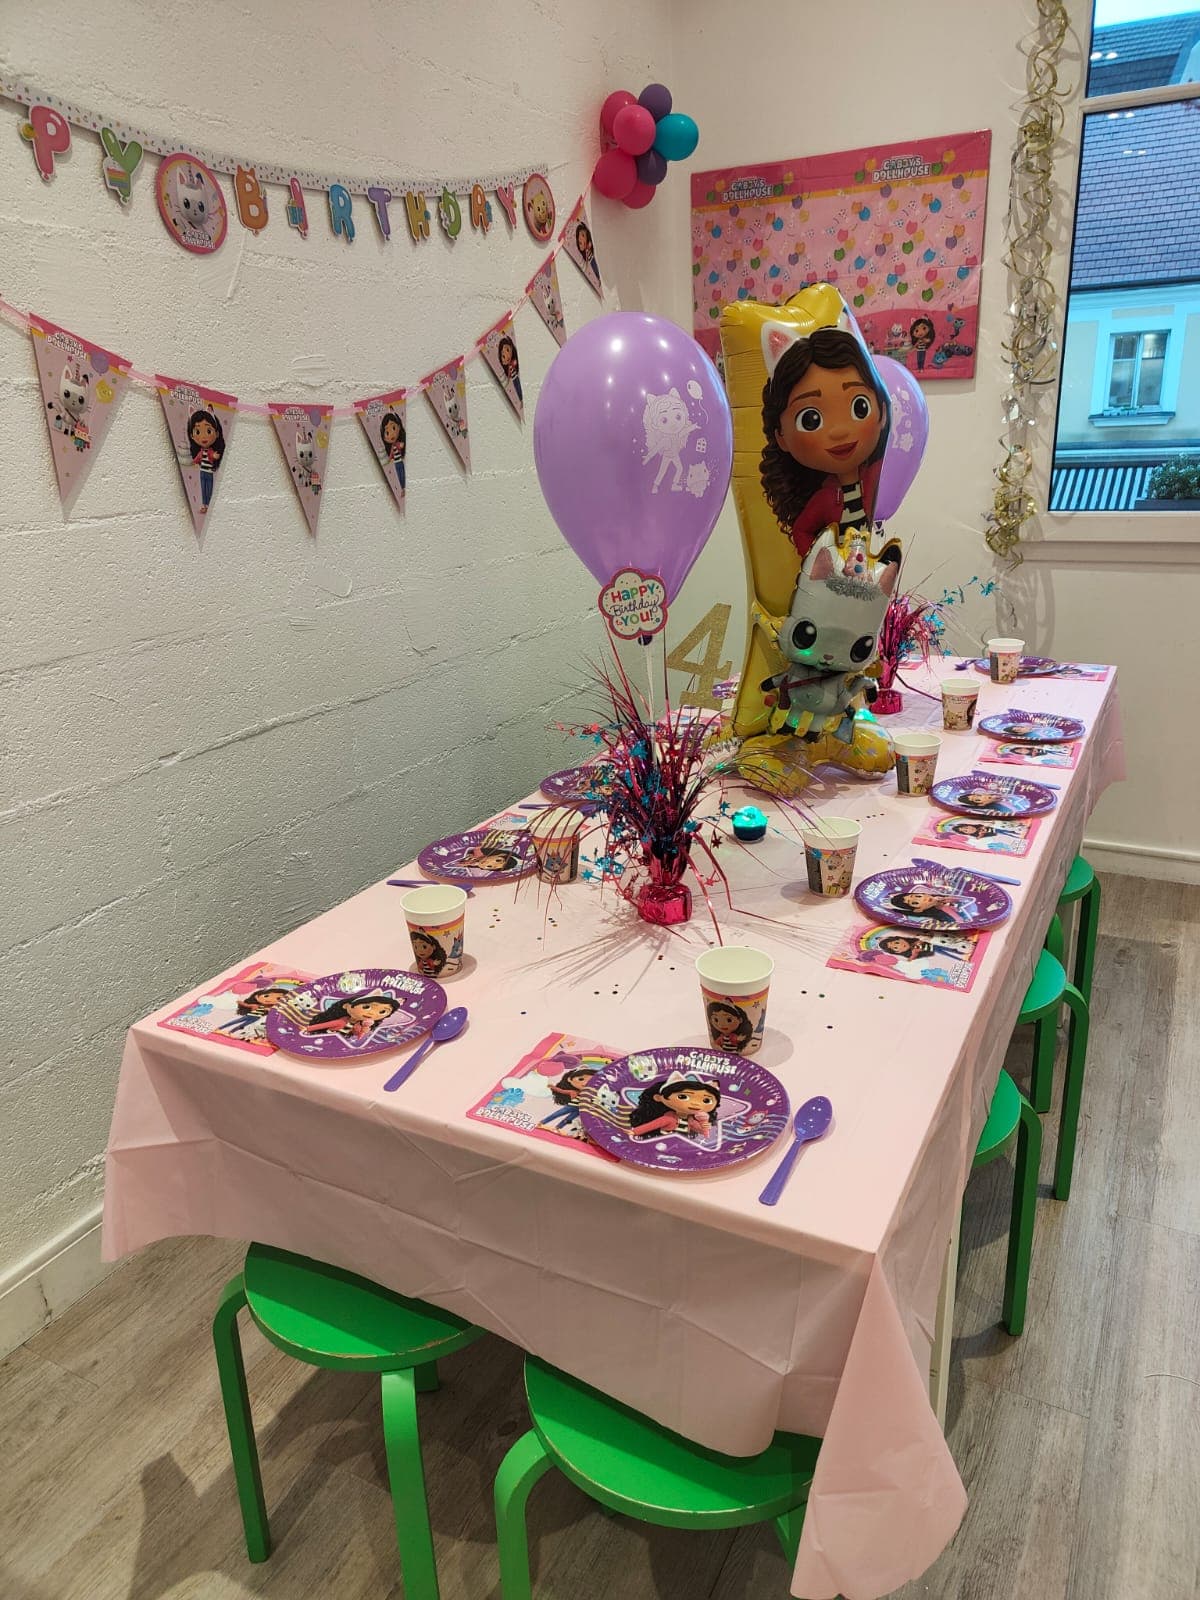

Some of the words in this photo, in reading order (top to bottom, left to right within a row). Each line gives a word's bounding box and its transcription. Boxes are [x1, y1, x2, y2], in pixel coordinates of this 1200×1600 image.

[873, 164, 930, 182] DOLLHOUSE
[233, 164, 519, 242] BIRTHDAY
[723, 185, 773, 201] DOLLHOUSE
[609, 594, 660, 617] Birthday
[665, 603, 733, 711] 4
[674, 1054, 738, 1075] DOLLHOUSE
